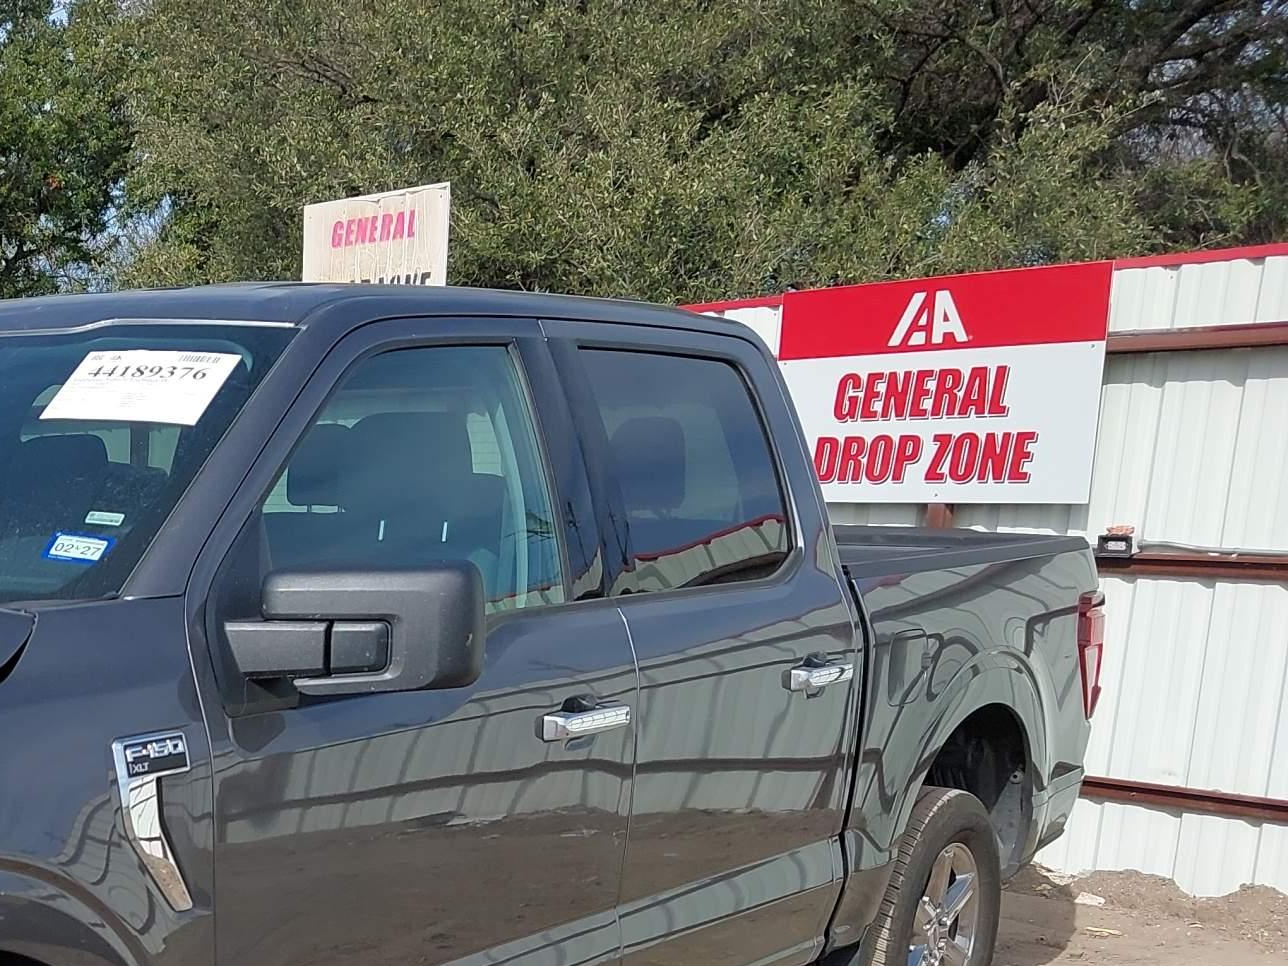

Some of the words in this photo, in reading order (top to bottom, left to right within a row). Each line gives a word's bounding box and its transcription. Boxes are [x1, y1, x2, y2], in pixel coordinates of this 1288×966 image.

[331, 209, 416, 248] GENERAL
[88, 364, 212, 381] 44189376
[832, 364, 1011, 424] GENERAL
[813, 434, 924, 485] DROP
[923, 431, 1039, 485] ZONE
[54, 542, 74, 553] 02
[80, 545, 102, 556] 27
[125, 739, 185, 763] F-150
[132, 762, 150, 774] XLT
